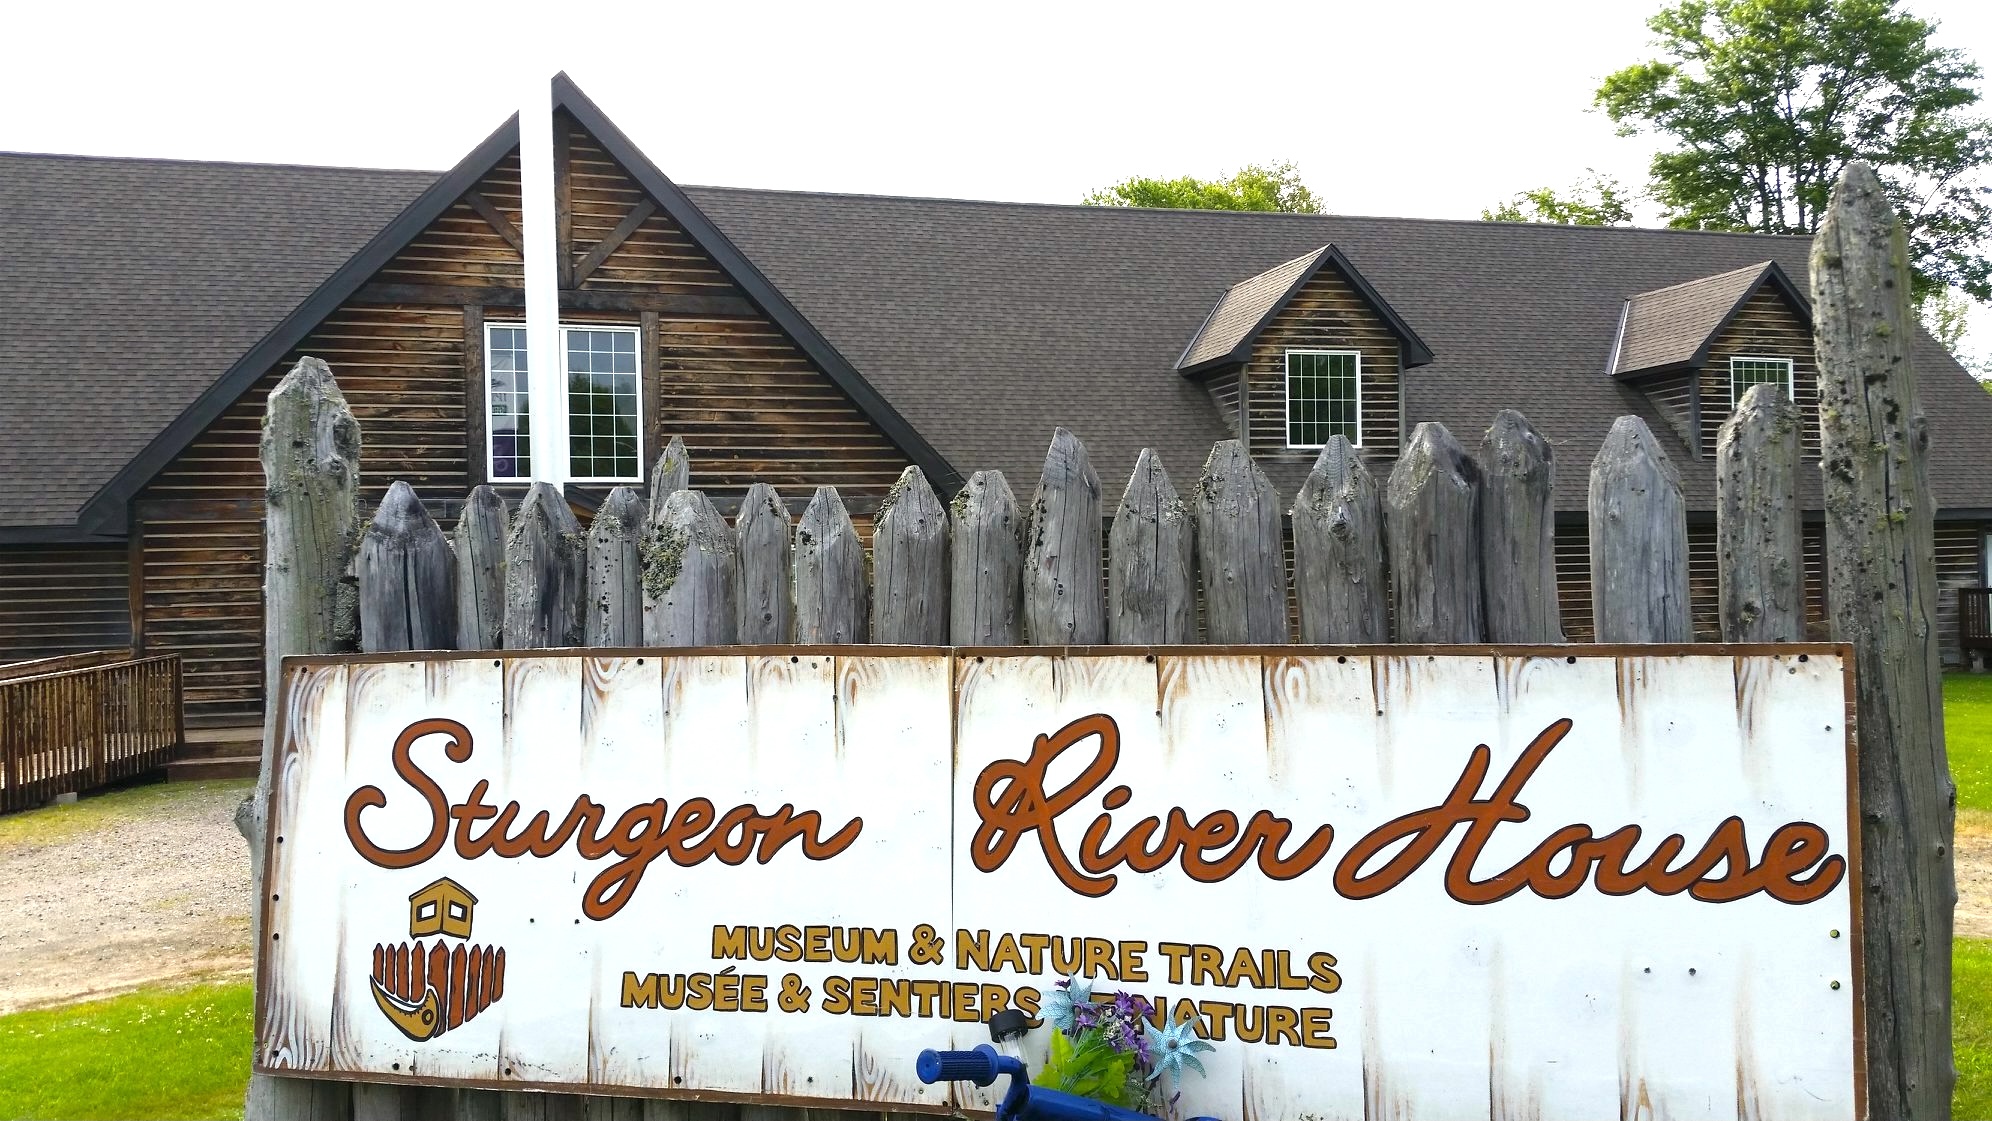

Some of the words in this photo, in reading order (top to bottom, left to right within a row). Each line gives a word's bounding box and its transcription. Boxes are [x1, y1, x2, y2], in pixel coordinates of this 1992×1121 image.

[344, 718, 863, 921] Sturgeon
[971, 713, 1334, 898] River
[1333, 717, 1846, 905] House
[712, 924, 898, 966] MUSEUM
[909, 924, 945, 964] &
[956, 929, 1148, 982] NATURE
[1159, 942, 1342, 993] TRAILS
[621, 966, 767, 1013] MUSÉE
[779, 971, 811, 1013] &
[822, 974, 1044, 1029] SENTIERS
